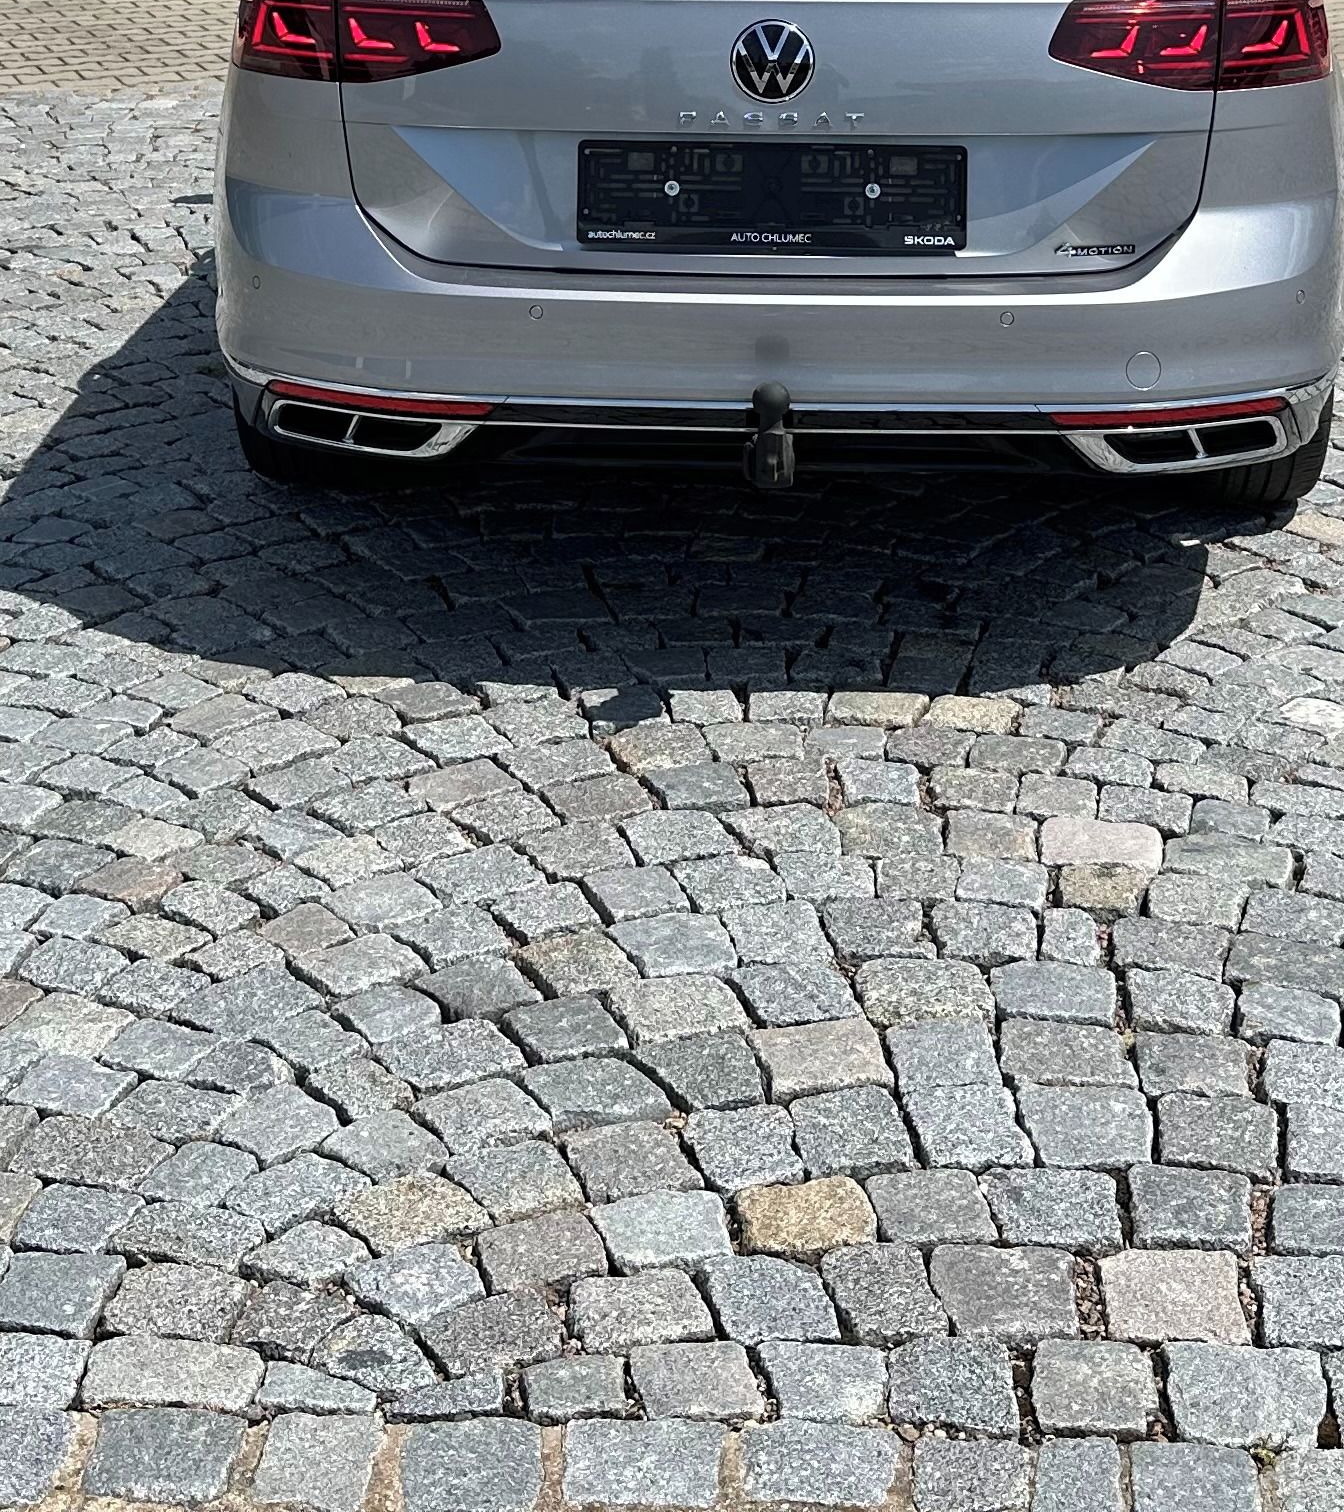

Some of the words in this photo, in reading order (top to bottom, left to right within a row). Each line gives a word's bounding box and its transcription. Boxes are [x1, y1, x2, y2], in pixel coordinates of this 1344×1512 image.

[679, 110, 865, 128] PASSAT
[587, 229, 656, 240] autochlumec.cz
[730, 232, 760, 242] AUTO
[761, 232, 812, 244] CHLUMEC
